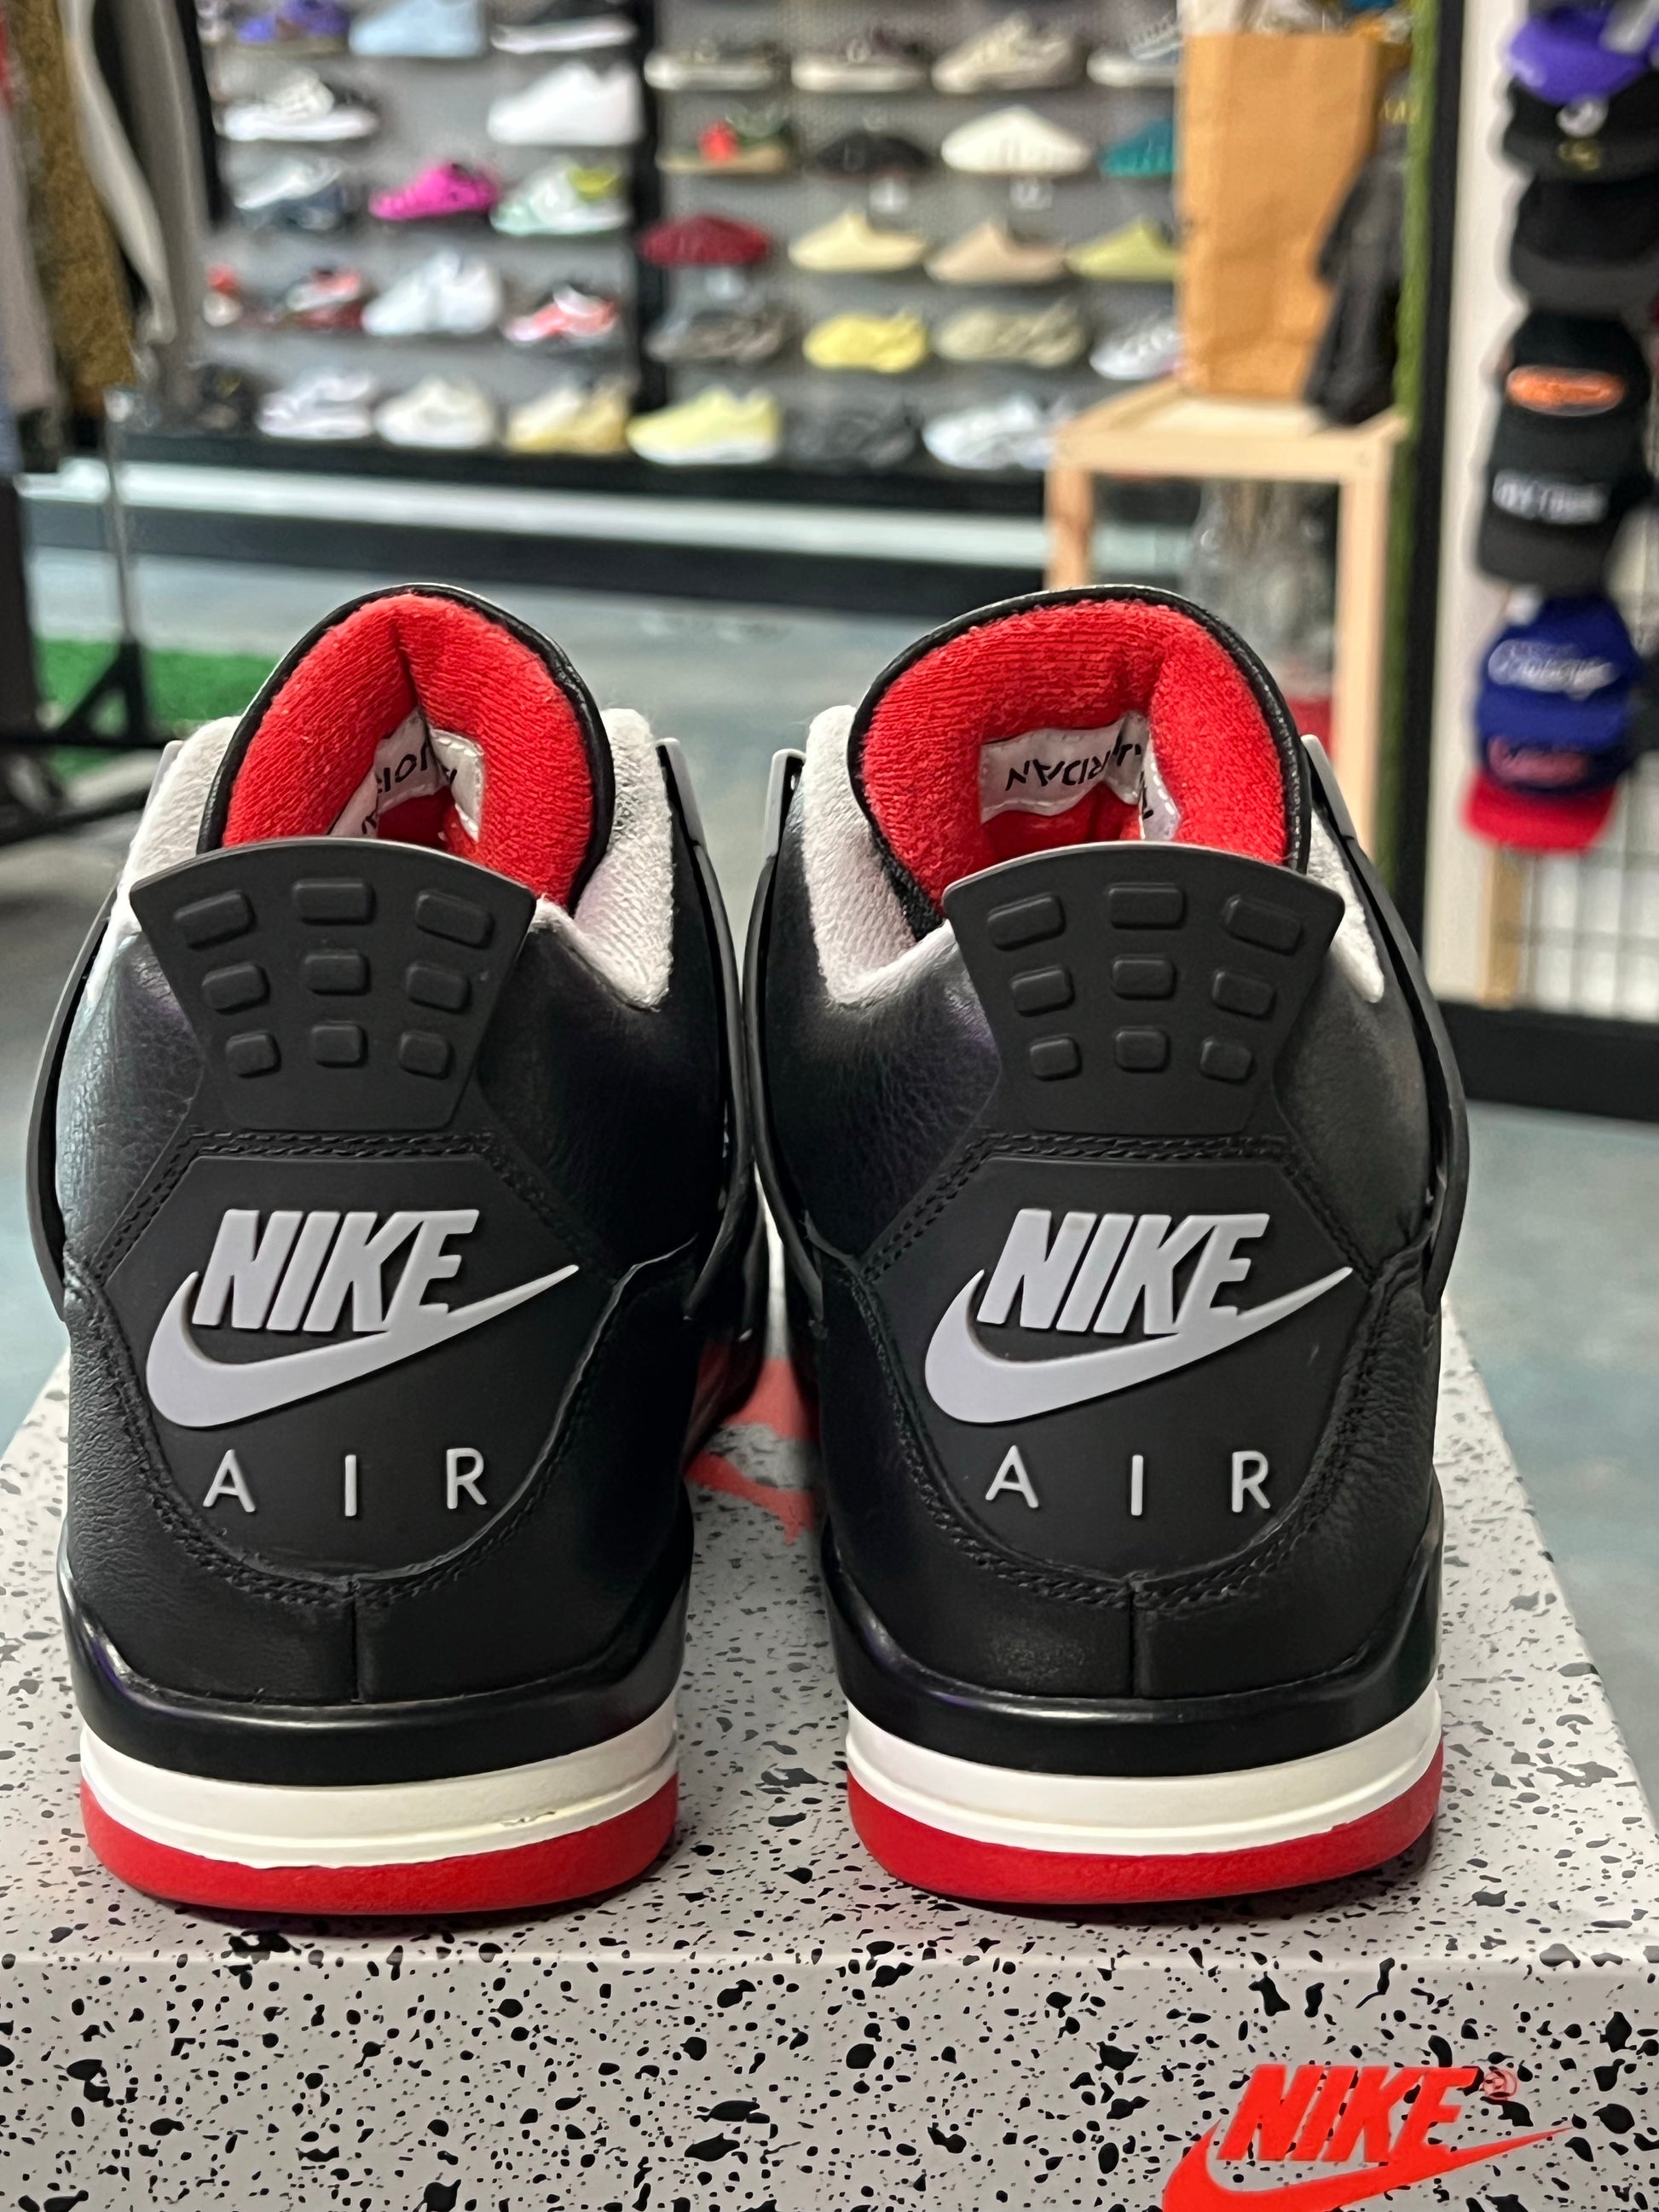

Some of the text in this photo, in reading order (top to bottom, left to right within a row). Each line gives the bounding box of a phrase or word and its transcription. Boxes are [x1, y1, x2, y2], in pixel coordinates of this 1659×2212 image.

[1004, 735, 1142, 792] JRDAN
[192, 1208, 480, 1332] NIKE
[976, 1208, 1269, 1335] NIKE
[202, 1447, 488, 1517] AIR
[985, 1444, 1271, 1517] AIR
[1216, 2064, 1480, 2163] NIKE
